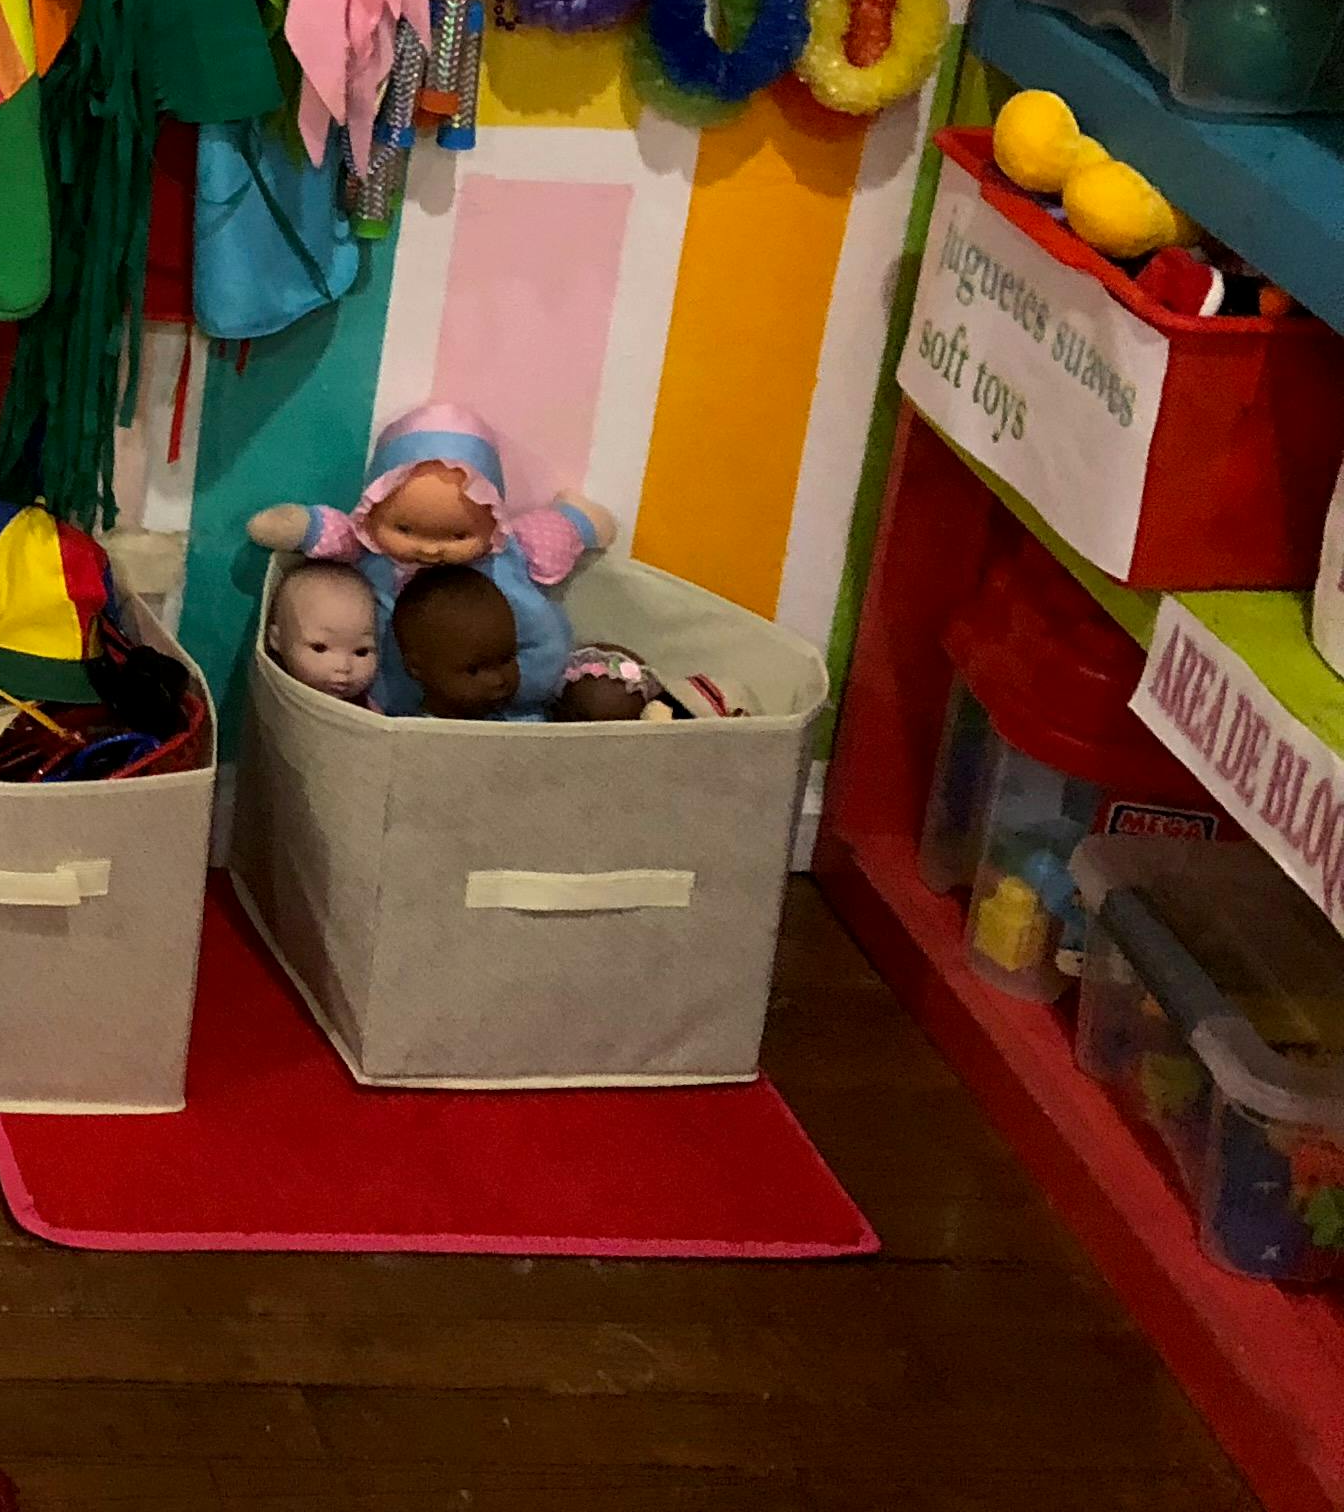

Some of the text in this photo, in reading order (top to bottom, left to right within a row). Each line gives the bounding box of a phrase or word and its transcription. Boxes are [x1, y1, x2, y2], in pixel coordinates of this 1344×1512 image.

[918, 319, 1028, 444] soft toys
[1051, 320, 1137, 428] suaves
[1149, 624, 1344, 921] AREA DE BLOQ
